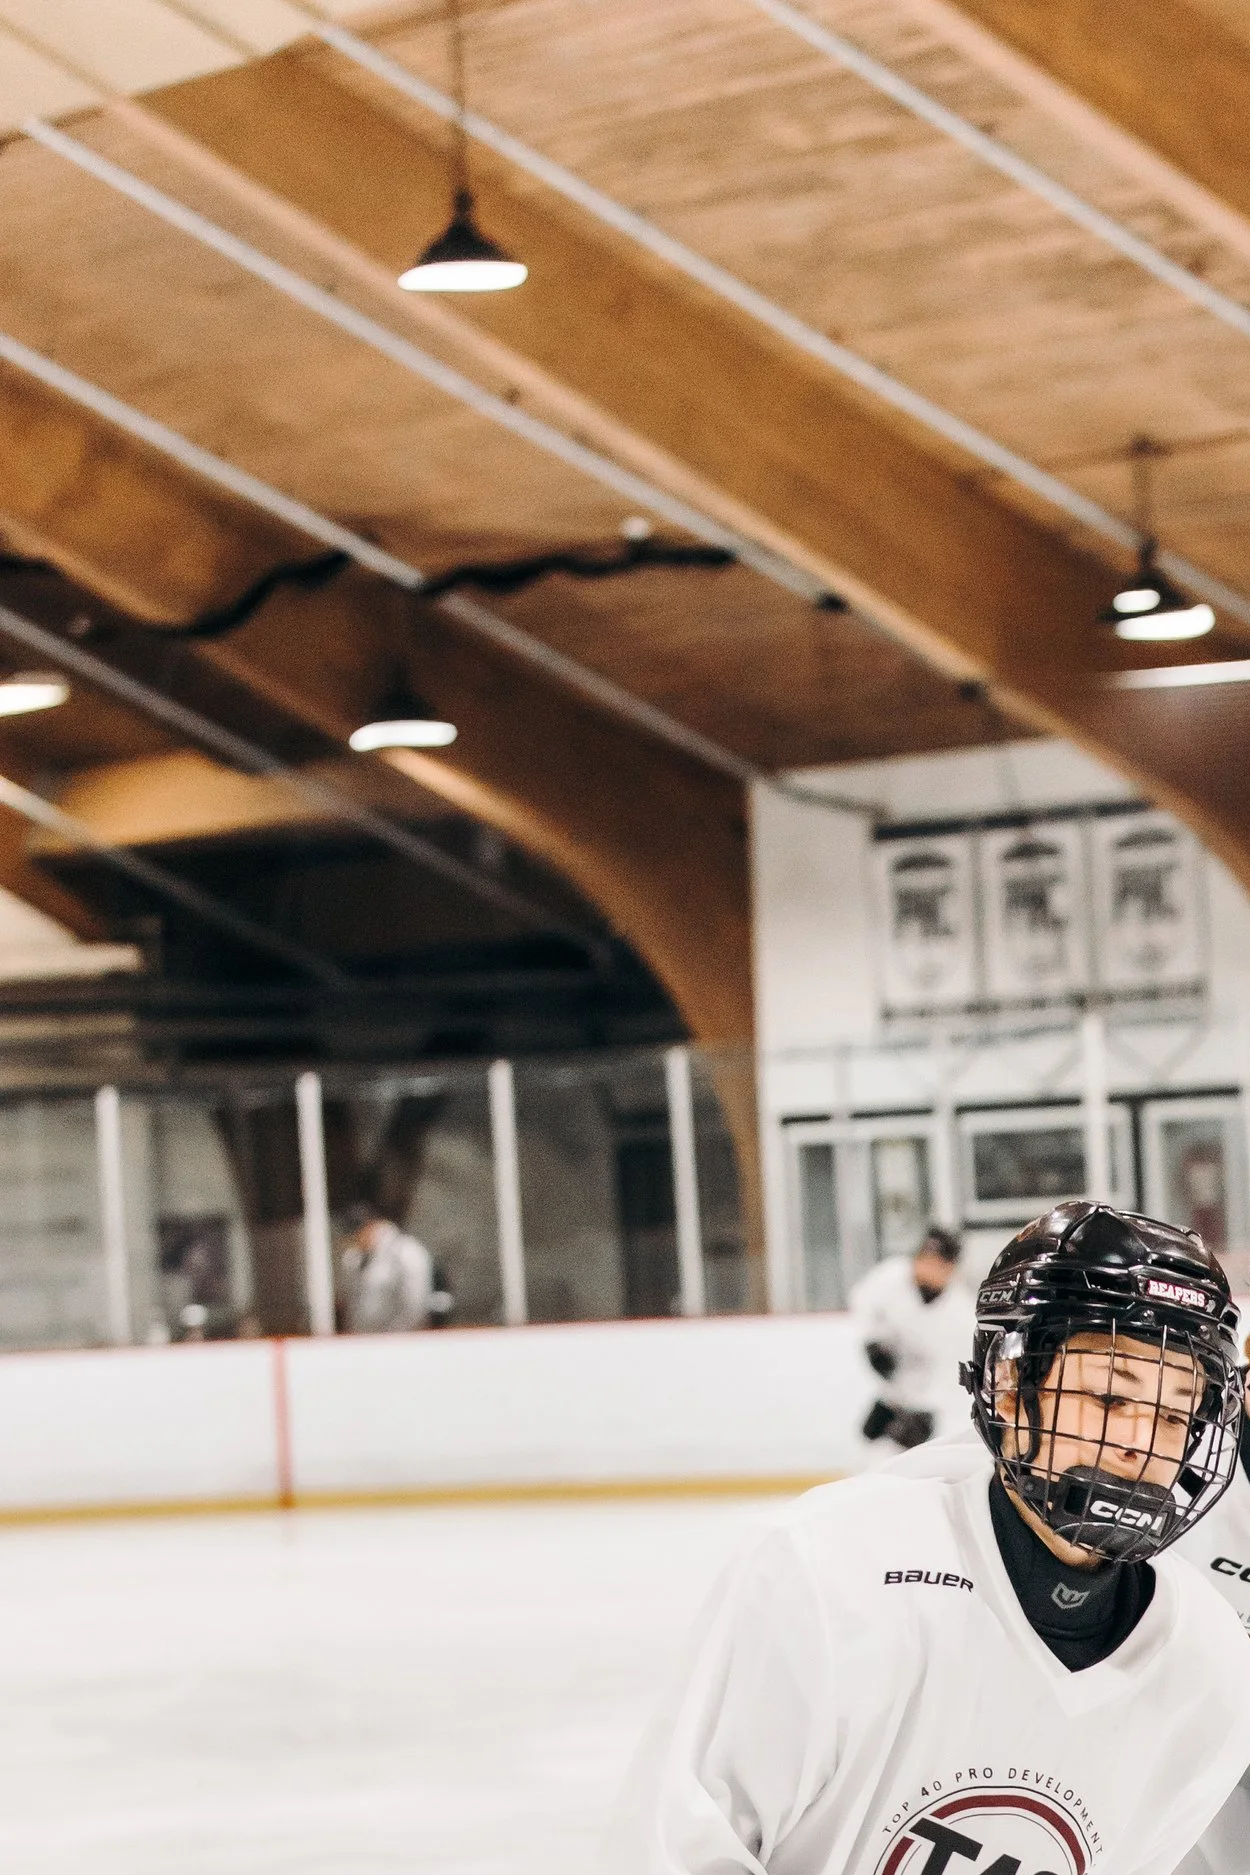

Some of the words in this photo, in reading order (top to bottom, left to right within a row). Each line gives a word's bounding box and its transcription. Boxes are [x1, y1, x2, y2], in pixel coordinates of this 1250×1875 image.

[980, 1290, 1012, 1303] CCM
[1149, 1281, 1205, 1307] REAPERS
[882, 1802, 910, 1834] TOP
[920, 1780, 942, 1797] 40
[955, 1767, 993, 1783] PRO
[1008, 1767, 1103, 1854] DEVELOPMENT
